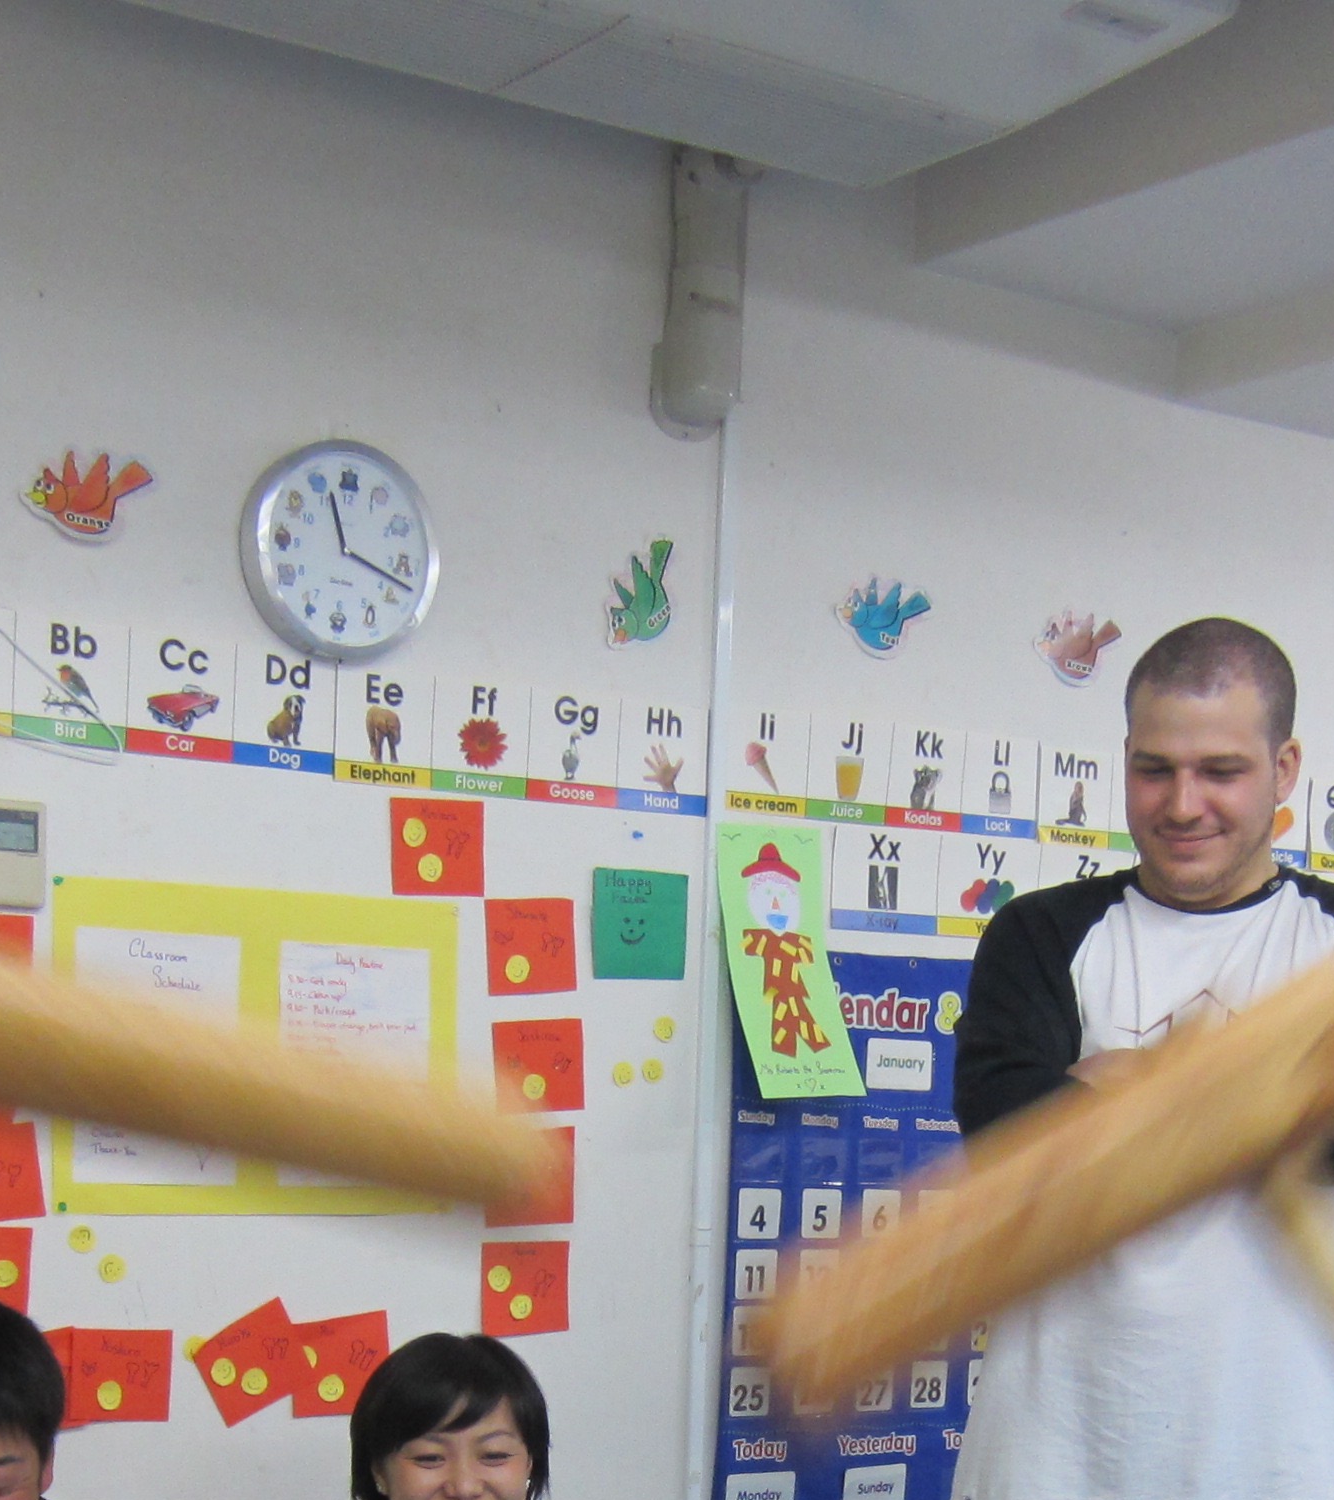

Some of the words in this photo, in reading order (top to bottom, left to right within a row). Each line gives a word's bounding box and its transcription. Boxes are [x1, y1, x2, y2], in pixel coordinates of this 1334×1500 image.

[342, 494, 354, 505] 12
[65, 512, 111, 529] Orange
[302, 512, 314, 525] 10
[293, 537, 301, 548] 9
[298, 564, 306, 576] 8
[387, 556, 394, 567] 3
[313, 588, 321, 599] 7
[377, 581, 384, 591] 4
[336, 600, 343, 611] 6
[360, 598, 367, 609] 5
[647, 604, 672, 628] Green
[50, 624, 98, 659] Bb
[159, 638, 209, 674] Cc
[266, 655, 312, 690] Dd
[366, 674, 404, 706] Ee
[471, 686, 498, 716] Ff
[554, 696, 599, 735] Gg
[646, 707, 682, 737] Hh
[54, 722, 87, 740] Bird
[759, 713, 776, 741] Ii
[166, 736, 195, 753] Car
[841, 722, 864, 756] Jj
[915, 730, 944, 759] Kk
[268, 748, 301, 770] Dog
[993, 740, 1010, 767] Ll
[350, 764, 416, 786] Elephant
[1054, 752, 1098, 780] Mm
[455, 775, 503, 793] Flower
[549, 784, 595, 801] Goose
[644, 793, 679, 810] Hand
[730, 794, 755, 810] Ice
[757, 799, 798, 814] cream
[829, 804, 863, 819] Juice
[904, 811, 943, 827] Koalas
[985, 818, 1012, 833] Lock
[868, 834, 901, 862] Xx
[1050, 830, 1096, 847] Monkey
[977, 843, 1006, 875] Yy
[1076, 855, 1100, 879] Zz
[1271, 851, 1294, 864] sicle
[605, 870, 652, 896] Happy
[867, 915, 899, 932] X-ray
[128, 938, 188, 963] Classroom
[842, 991, 929, 1031] endar
[936, 993, 963, 1032] &
[876, 1054, 925, 1072] January
[738, 1110, 775, 1125] Sunday
[802, 1113, 838, 1129] Monday
[863, 1116, 899, 1131] Tuesday
[750, 1205, 766, 1232] 4
[813, 1205, 828, 1231] 5
[872, 1205, 887, 1231] 6
[744, 1265, 766, 1292] 11
[733, 1384, 764, 1411] 25
[860, 1380, 888, 1406] 27
[914, 1377, 941, 1403] 28
[733, 1438, 787, 1461] Today
[839, 1433, 916, 1456] Yesterday
[943, 1430, 963, 1449] To
[857, 1481, 894, 1495] Sunday
